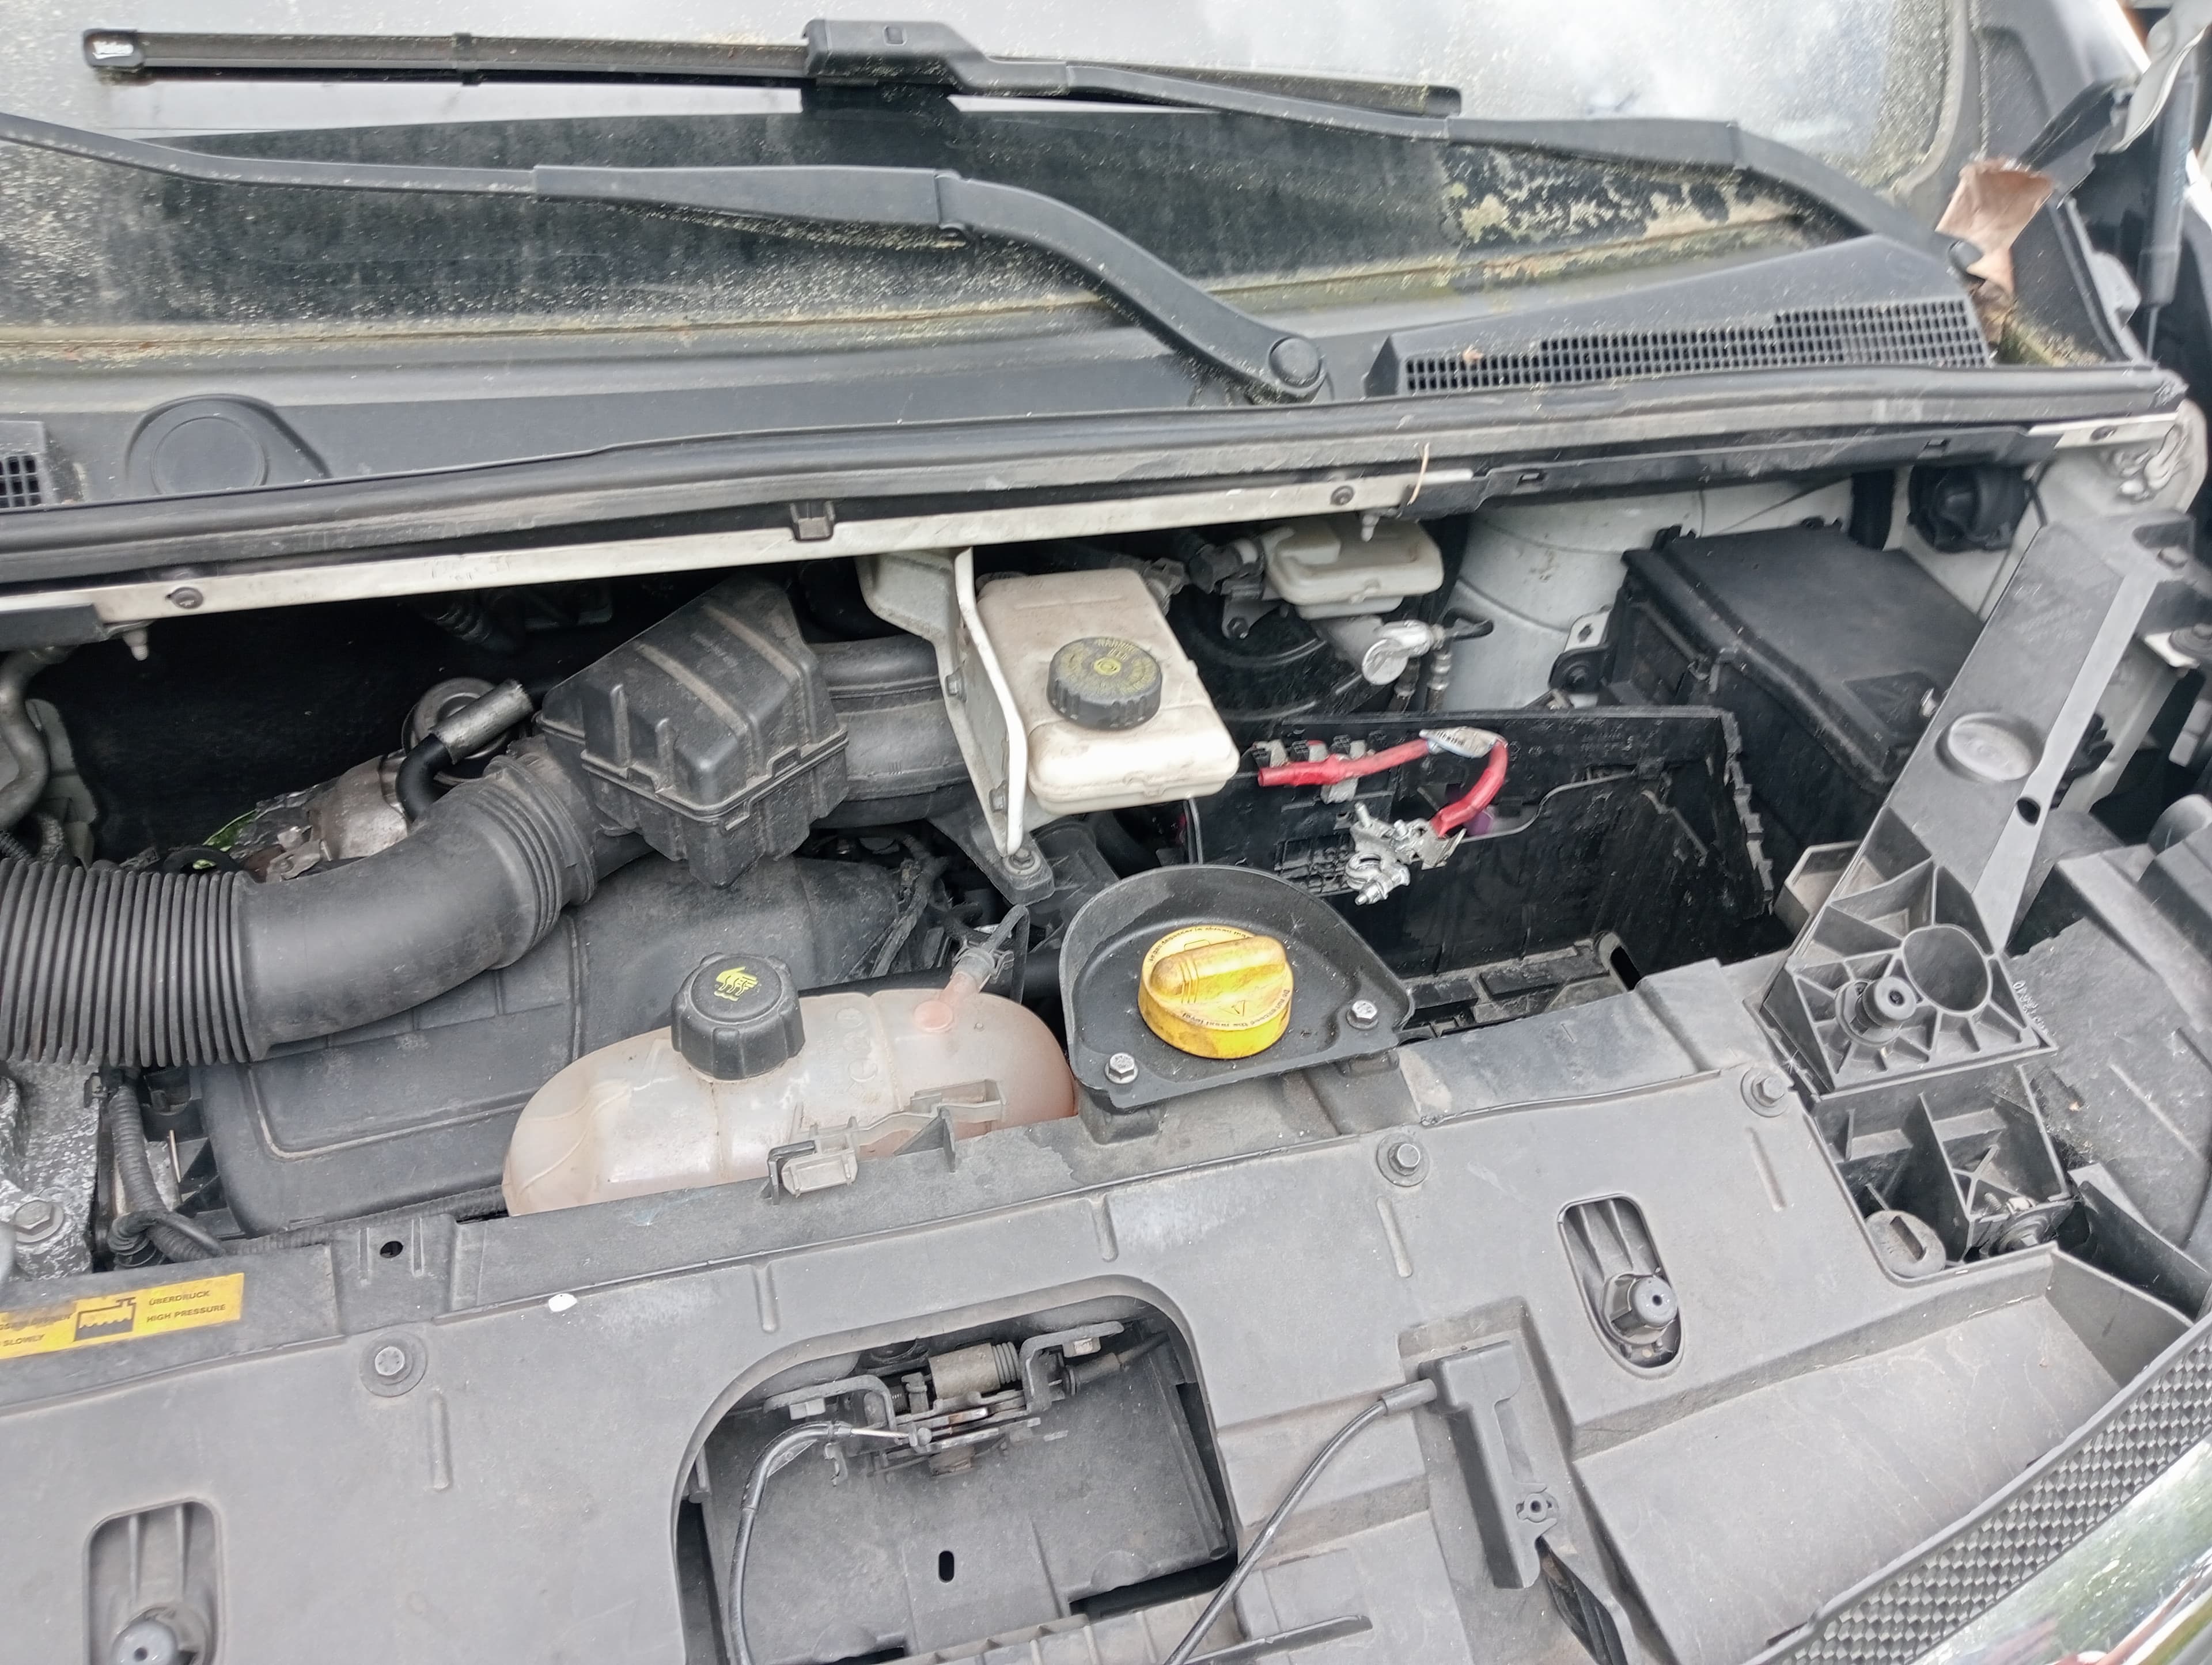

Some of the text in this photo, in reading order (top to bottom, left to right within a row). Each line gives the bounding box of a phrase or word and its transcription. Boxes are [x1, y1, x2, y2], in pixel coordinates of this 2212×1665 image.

[146, 1304, 226, 1322] HIGH PRESSURE
[3, 1334, 46, 1347] SLOWLY
